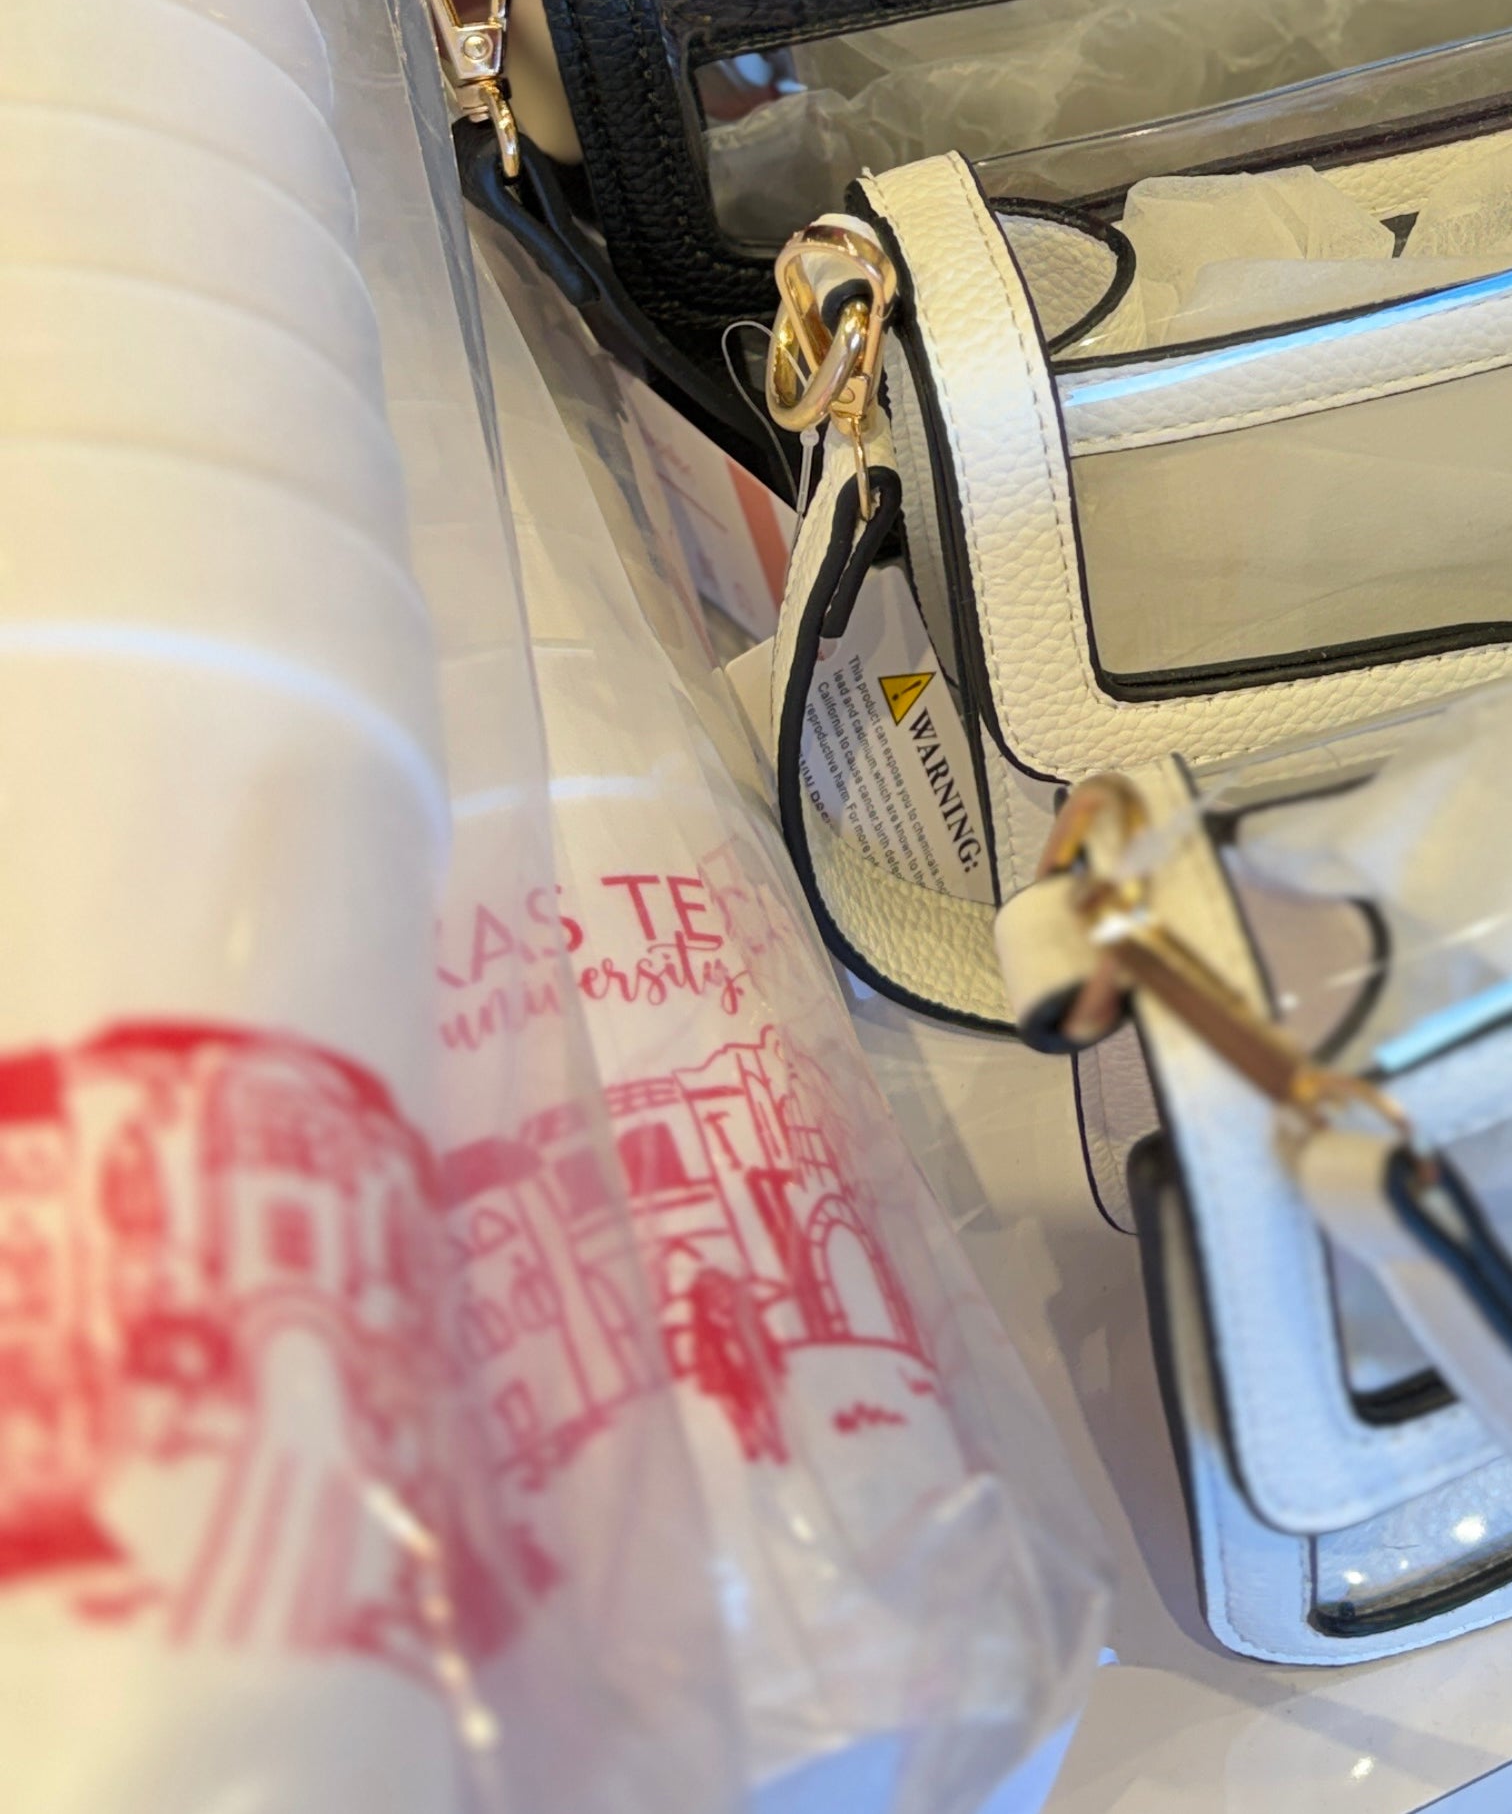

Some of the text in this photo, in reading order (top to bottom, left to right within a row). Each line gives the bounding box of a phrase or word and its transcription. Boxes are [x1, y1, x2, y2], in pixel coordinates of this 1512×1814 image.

[817, 681, 845, 737] California
[839, 737, 850, 749] to
[848, 655, 864, 682] This
[856, 681, 882, 724] product
[875, 725, 889, 746] can
[882, 747, 904, 787] expose
[896, 788, 913, 809] you
[907, 807, 918, 821] to
[802, 702, 839, 773] reproductive
[845, 802, 860, 823] For
[854, 824, 870, 853] more
[833, 669, 850, 695] lead
[842, 696, 859, 718] and
[873, 770, 892, 802] which
[886, 804, 899, 822] are
[893, 821, 914, 859] known
[908, 858, 919, 871] to
[844, 750, 863, 783] cause
[908, 708, 983, 873] WARNING:
[873, 822, 890, 849] birth
